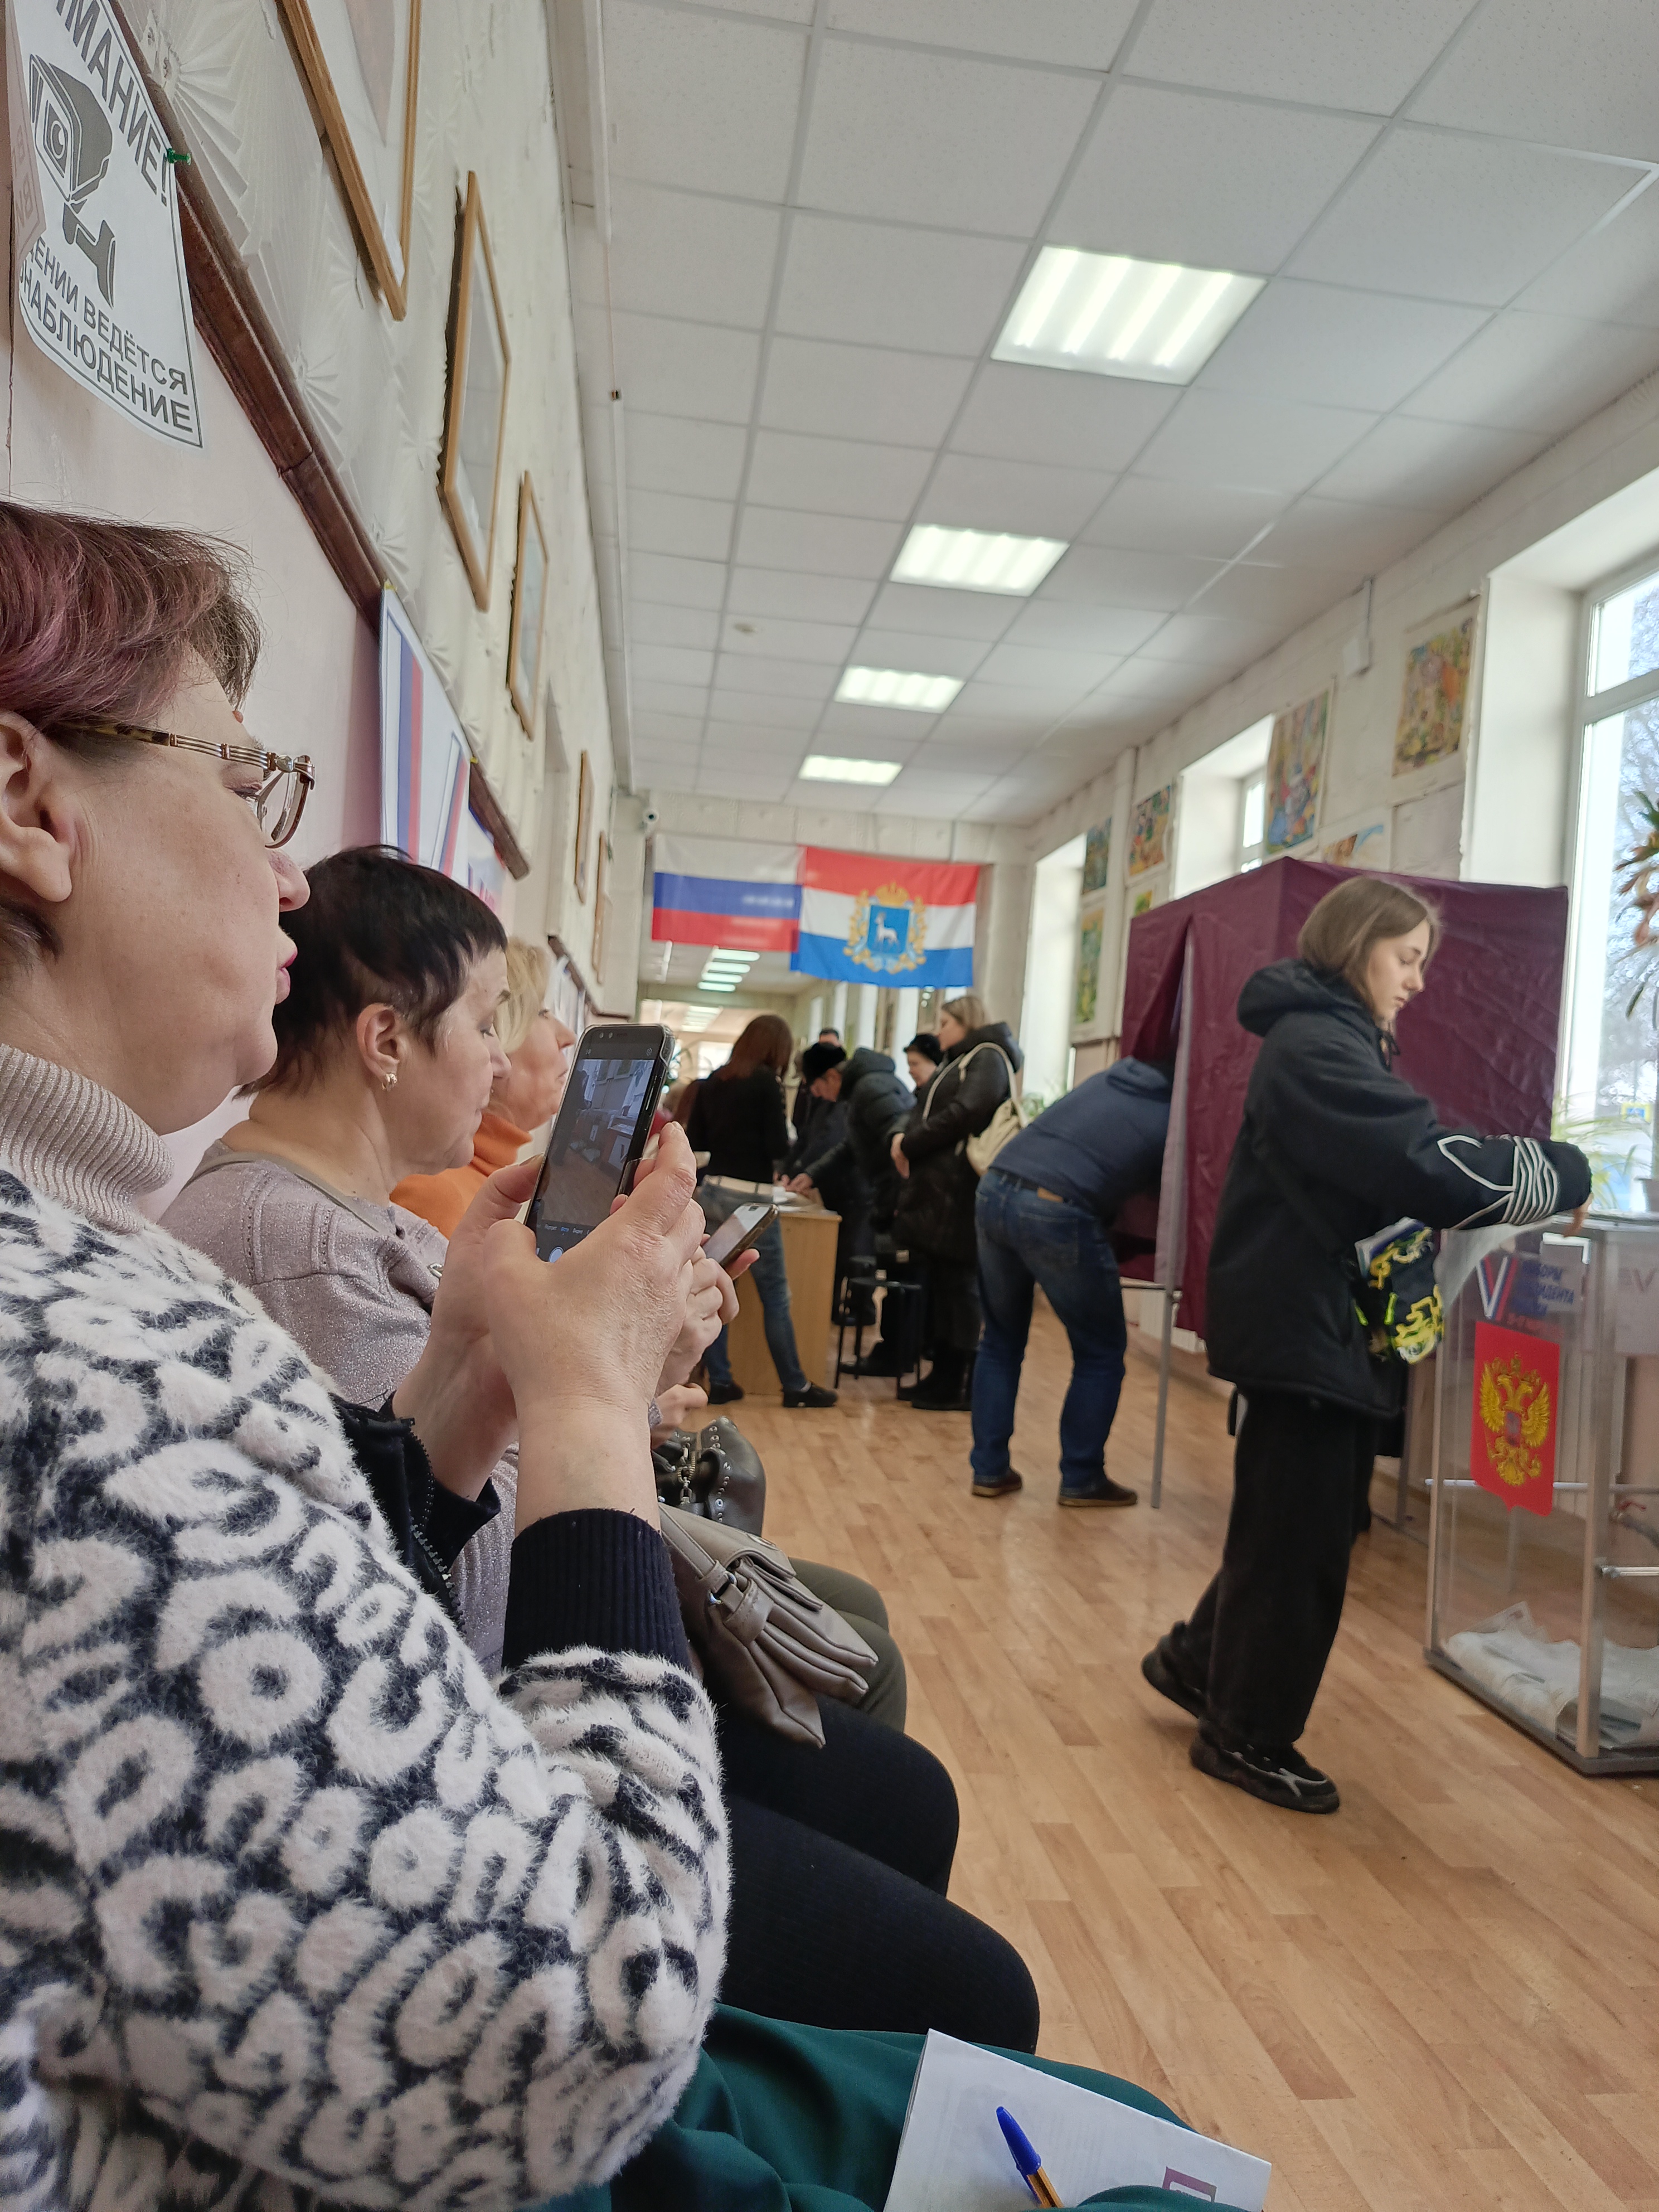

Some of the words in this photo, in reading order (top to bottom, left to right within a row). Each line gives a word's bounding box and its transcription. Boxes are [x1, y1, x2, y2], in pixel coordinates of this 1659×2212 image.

[56, 0, 167, 207] МАНИЕ!
[30, 237, 78, 312] ЕНИИ
[84, 296, 188, 395] ВЕДЁТСЯ
